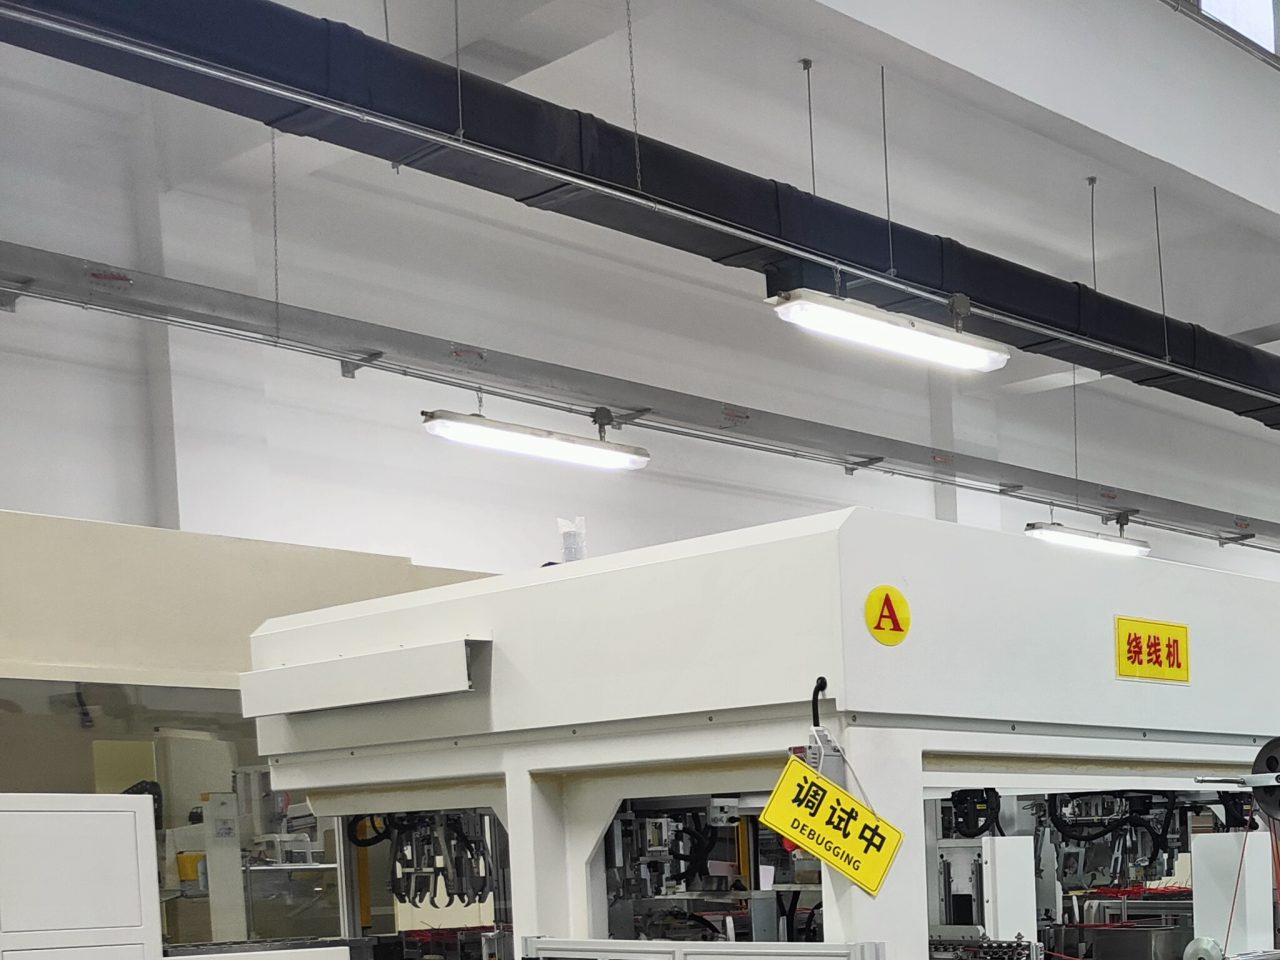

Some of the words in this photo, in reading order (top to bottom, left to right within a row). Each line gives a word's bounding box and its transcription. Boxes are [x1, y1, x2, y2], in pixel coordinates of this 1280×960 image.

[873, 592, 904, 632] A
[1126, 632, 1182, 669] 绕线机
[791, 775, 887, 855] 调试中
[790, 817, 862, 871] DEBUGGING
